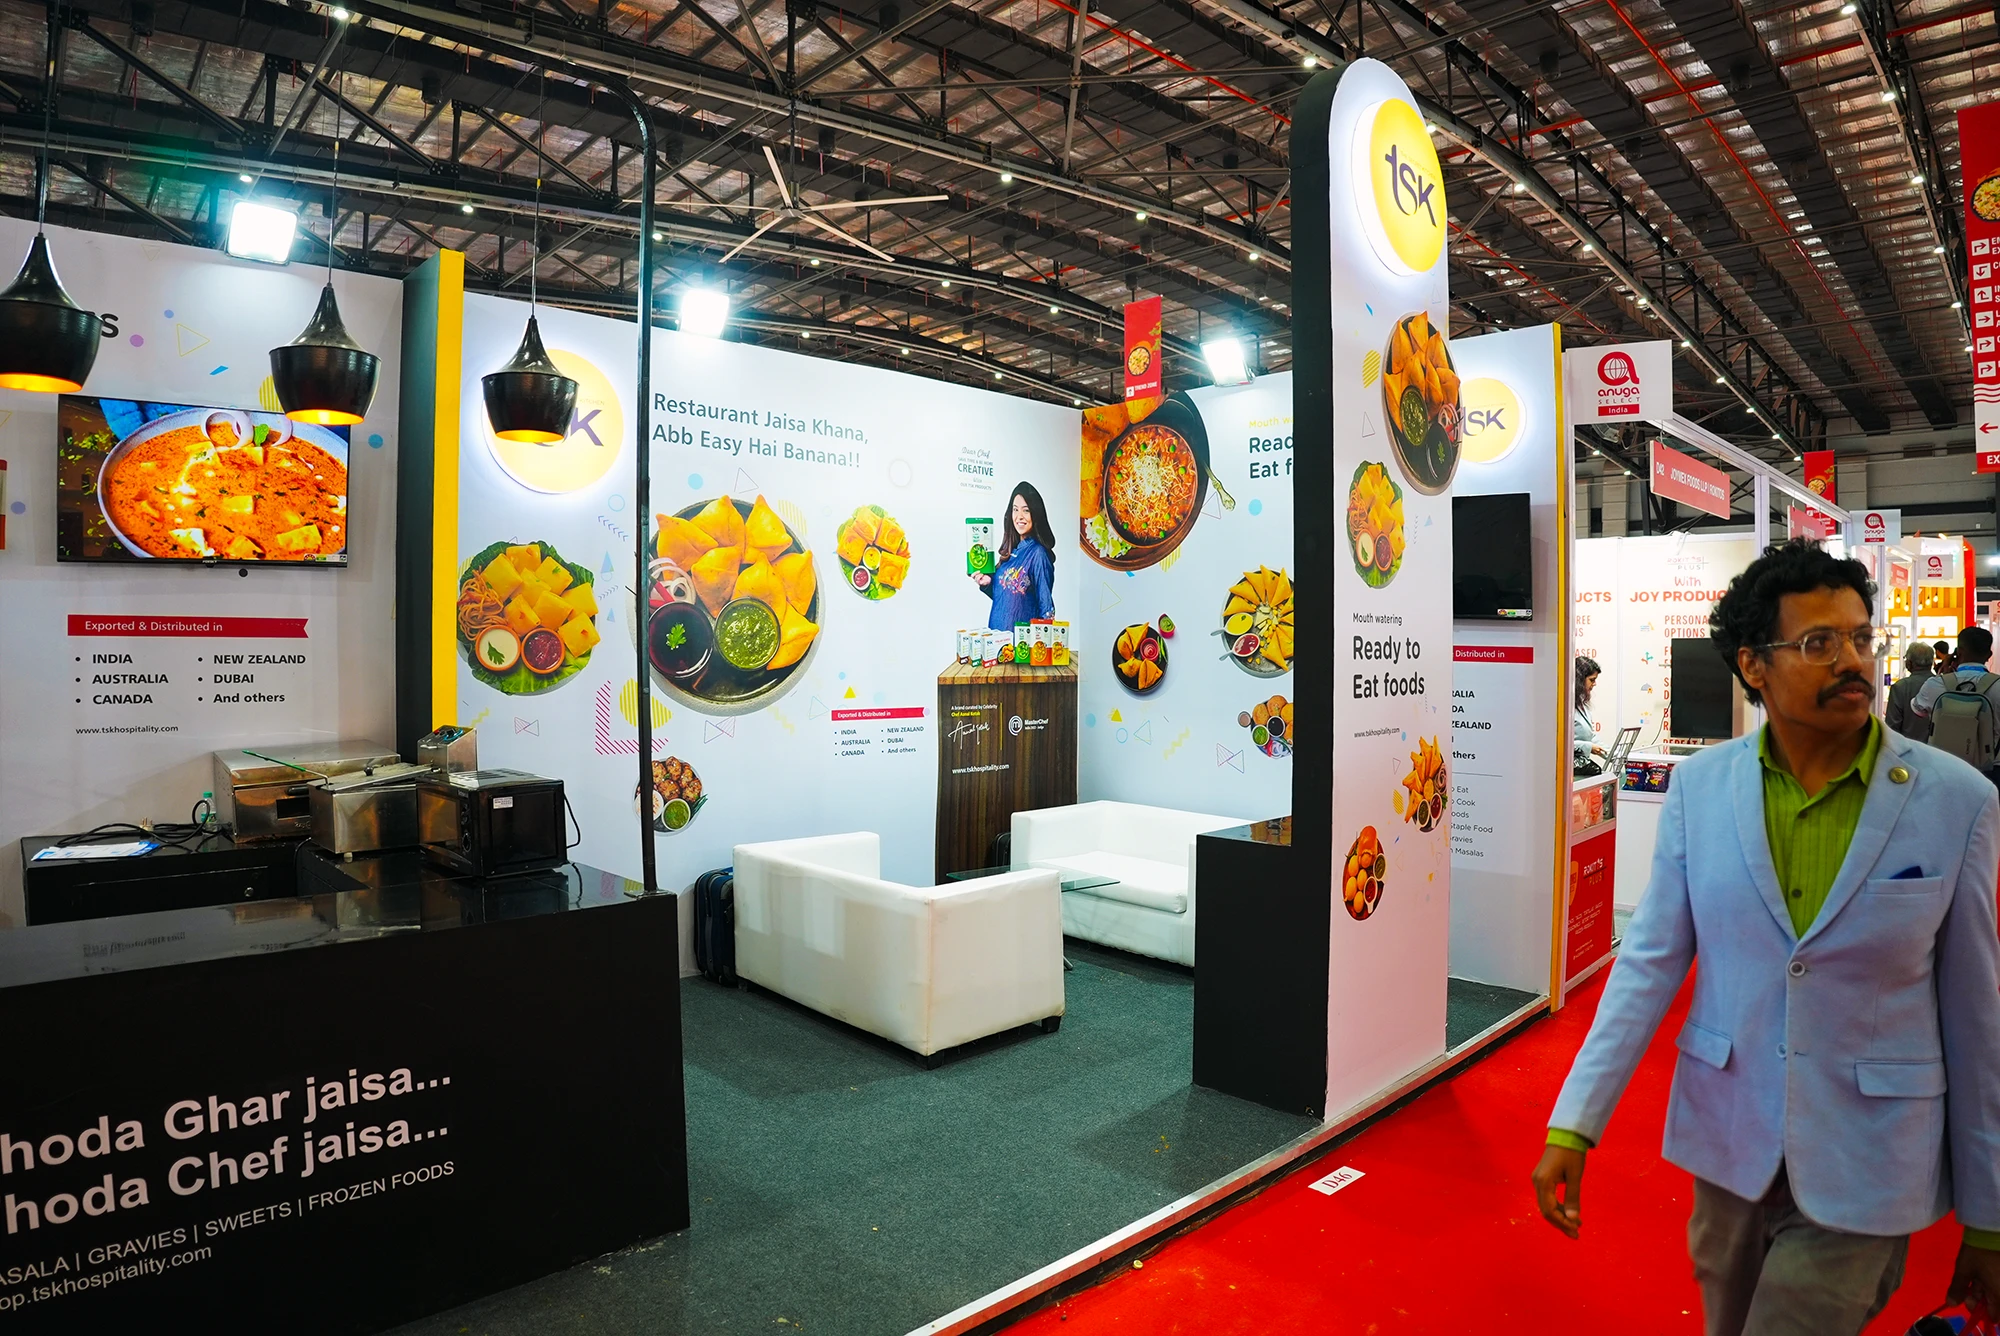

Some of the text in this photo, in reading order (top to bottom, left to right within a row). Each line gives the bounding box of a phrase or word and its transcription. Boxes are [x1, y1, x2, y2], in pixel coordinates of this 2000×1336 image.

[1598, 387, 1640, 398] anuga
[654, 393, 868, 444] Restaurant Jaisa Khana,
[1249, 417, 1279, 428] Mouth
[652, 424, 859, 468] Abb Easy Hai Banana!!
[958, 463, 994, 476] CREATIVE
[1250, 461, 1278, 478] Eat
[1687, 474, 1700, 490] FOODS
[1674, 576, 1702, 587] With
[1630, 591, 1659, 602] JOY
[1353, 612, 1403, 626] Mouth watering
[85, 621, 222, 632] Exported & Distributed in
[1664, 627, 1705, 638] OPTIONS
[1353, 635, 1420, 664] Ready to
[1456, 650, 1505, 658] Distributed in
[92, 654, 133, 664] INDIA
[214, 655, 306, 664] NEW ZEALAND
[92, 674, 169, 684] AUSTRALIA
[214, 674, 254, 684] DUBAI
[1353, 671, 1425, 699] Eat foods
[92, 694, 153, 705] CANADA
[213, 692, 285, 703] And others
[76, 724, 178, 735] www.tskhospitality.com
[1452, 751, 1476, 759] thers
[952, 764, 1009, 774] www.tskhospitality.com
[1457, 786, 1469, 794] Eat
[1456, 798, 1476, 806] Cook
[1473, 825, 1493, 833] Food
[1450, 836, 1473, 844] ravies
[1455, 848, 1484, 857] Masalas
[164, 1090, 291, 1140] Ghar
[303, 1068, 451, 1124] jaisa...
[168, 1136, 289, 1196] Chef
[301, 1120, 448, 1178] jaisa...
[1322, 1172, 1352, 1188] D46
[88, 1228, 187, 1264] GRAVIES
[205, 1202, 292, 1237] SWEETS
[308, 1178, 386, 1211] FROZEN
[392, 1161, 454, 1189] FOODS
